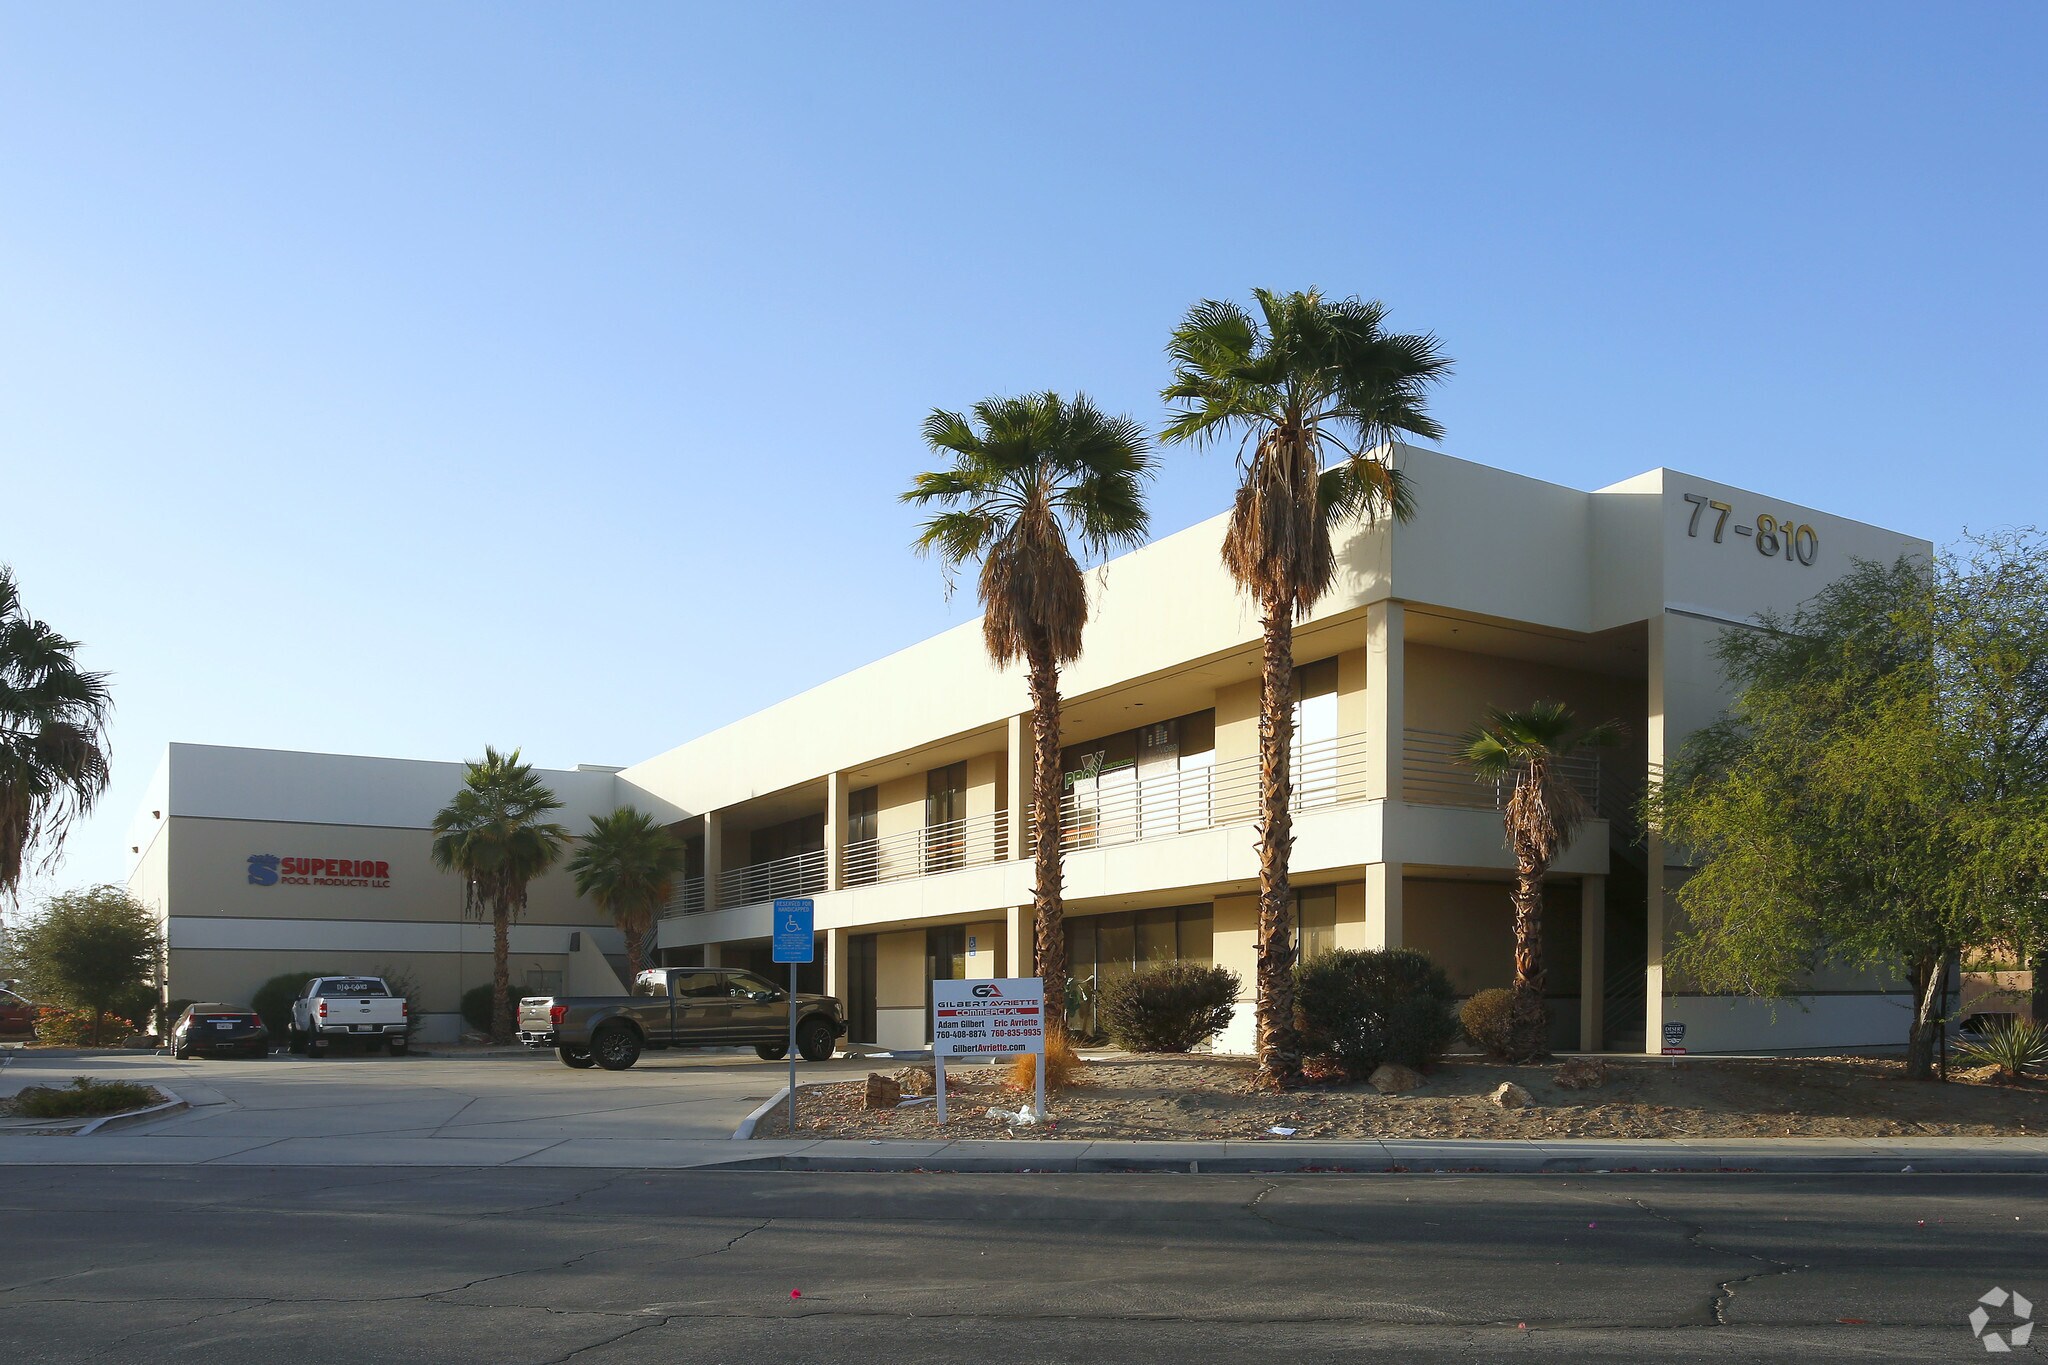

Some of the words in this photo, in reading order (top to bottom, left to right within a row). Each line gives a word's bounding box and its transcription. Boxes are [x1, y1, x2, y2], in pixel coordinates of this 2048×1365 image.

[1684, 493, 1819, 566] 77-810
[281, 857, 390, 878] SUPERIOR
[281, 877, 311, 886] POOL
[313, 878, 369, 887] PRODUCTS
[372, 880, 390, 888] LLC
[938, 1000, 988, 1008] GILBERT
[989, 999, 1039, 1007] AVRIETTE
[955, 1008, 1021, 1017] COMMERCIAL
[938, 1020, 958, 1029] Adam
[960, 1020, 985, 1028] Gilbert
[994, 1019, 1008, 1027] Eric
[1010, 1018, 1038, 1027] Avriette
[936, 1030, 987, 1039] 760-408-8874
[991, 1029, 1042, 1037] 760-835-9935
[952, 1043, 1026, 1053] GilbertAvriette.com
